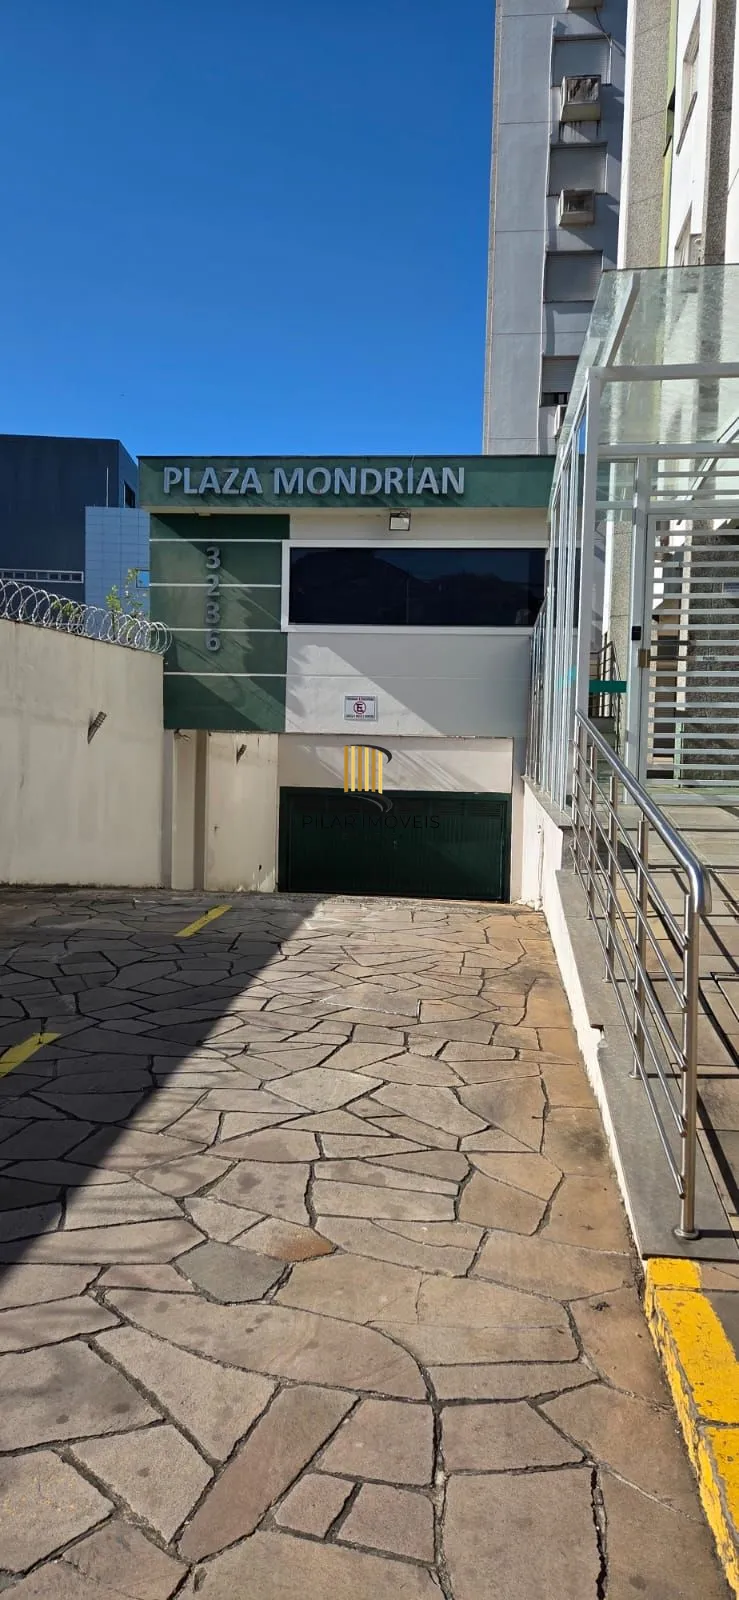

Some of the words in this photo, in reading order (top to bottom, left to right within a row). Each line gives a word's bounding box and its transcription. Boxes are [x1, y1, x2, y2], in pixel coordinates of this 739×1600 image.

[163, 467, 264, 495] PLAZA
[273, 466, 466, 496] MONDRIAN
[205, 546, 222, 653] 3236
